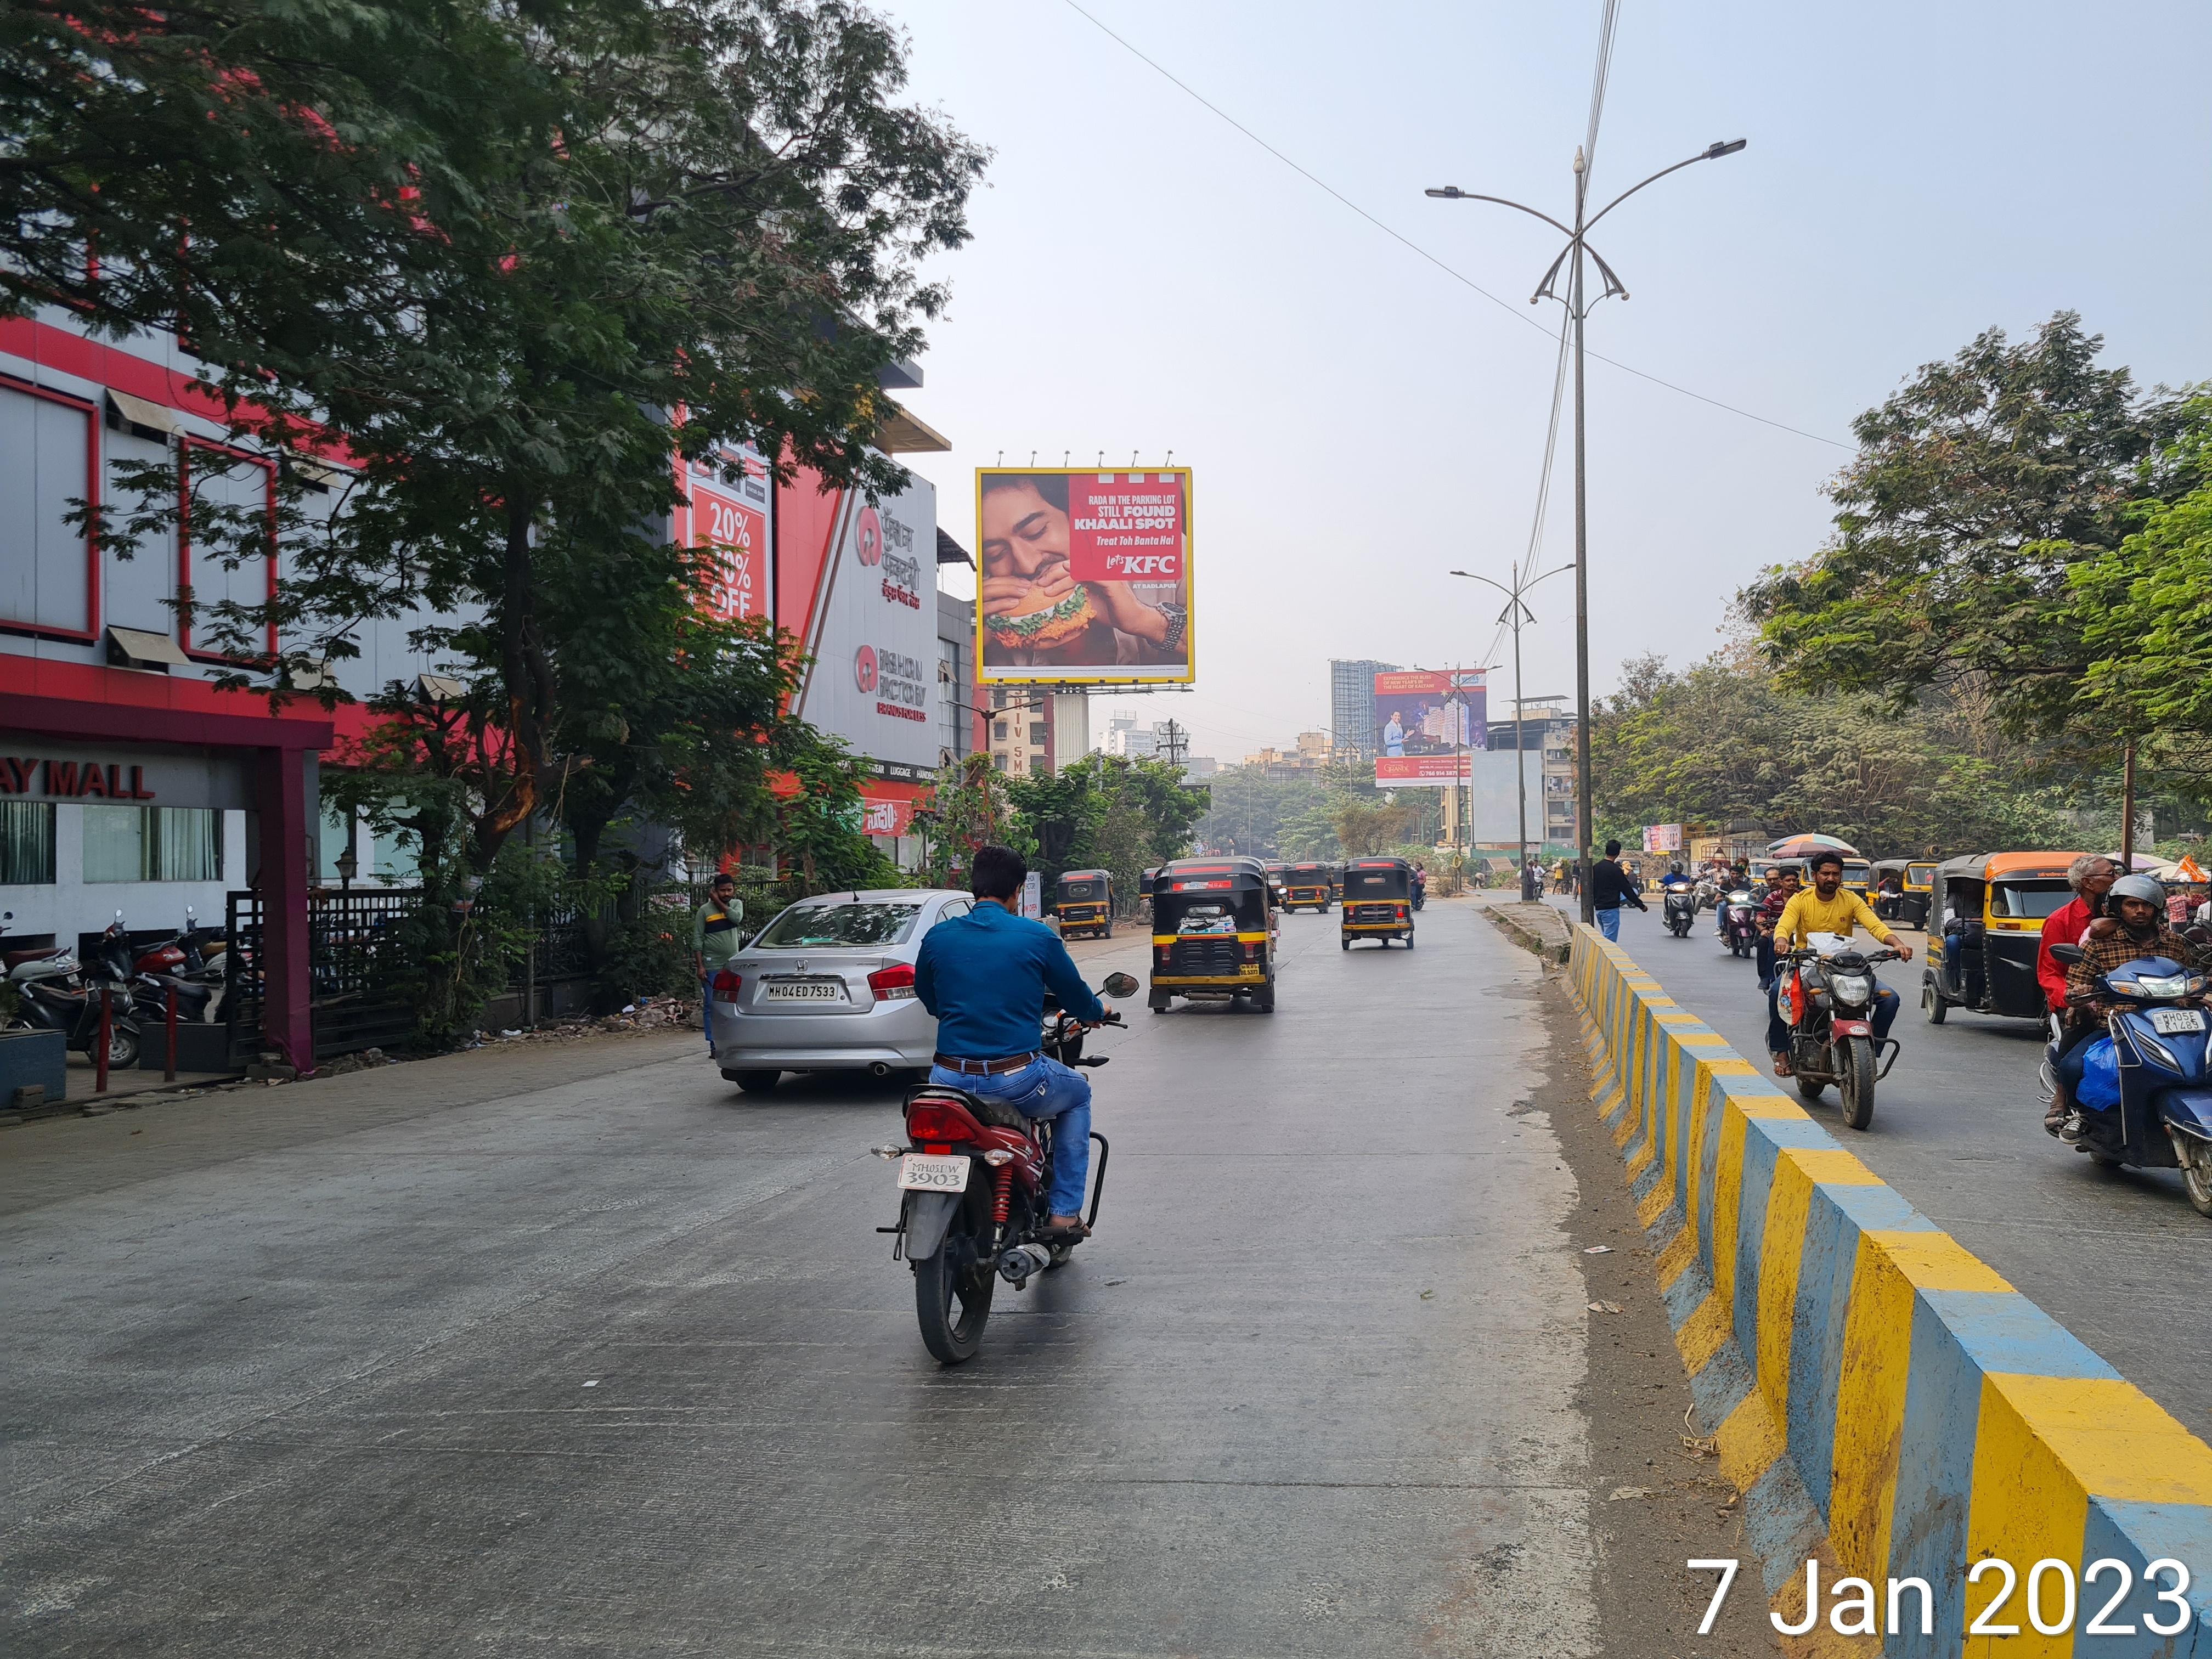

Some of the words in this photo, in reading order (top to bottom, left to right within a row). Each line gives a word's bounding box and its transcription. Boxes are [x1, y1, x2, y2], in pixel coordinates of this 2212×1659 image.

[1088, 496, 1107, 505] RADA
[1109, 496, 1116, 505] IN
[1118, 495, 1130, 505] THE
[1132, 495, 1162, 504] PARKING
[1163, 495, 1176, 504] LOT
[1098, 506, 1120, 517] STILL
[1124, 505, 1176, 517] FOUND
[710, 502, 751, 548] 20%
[1075, 518, 1132, 530] KHAALI
[1135, 518, 1176, 529] SPOT
[1097, 536, 1117, 546] Treat
[1120, 536, 1133, 545] Toh
[1135, 535, 1159, 545] Banta
[1160, 535, 1175, 545] Hai
[1107, 554, 1125, 569] Let's
[1122, 555, 1176, 574] KFC
[876, 648, 923, 681] FASHION
[876, 674, 927, 707] FACTORY
[877, 702, 903, 718] BRANDS
[902, 707, 913, 720] FOR
[913, 709, 926, 723] LESS
[44, 760, 156, 799] MALL
[890, 766, 911, 777] LUGGAGE
[906, 1172, 961, 1186] 3903
